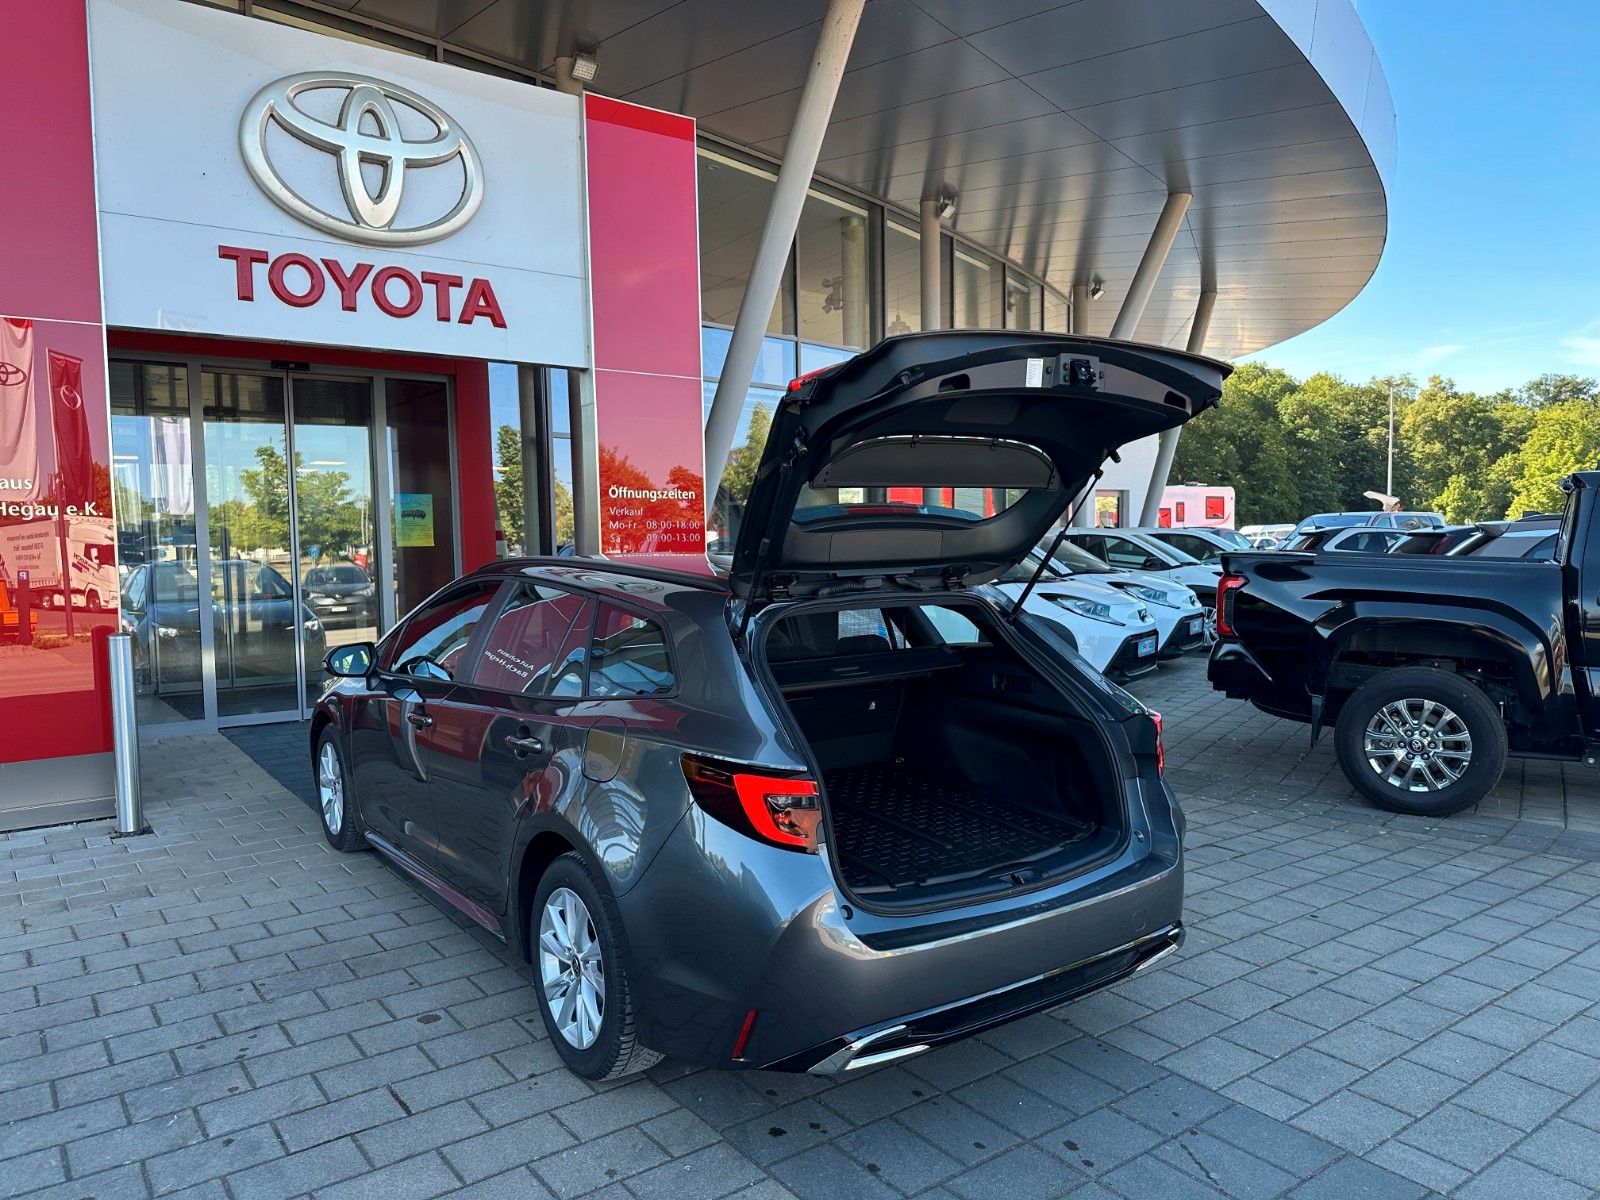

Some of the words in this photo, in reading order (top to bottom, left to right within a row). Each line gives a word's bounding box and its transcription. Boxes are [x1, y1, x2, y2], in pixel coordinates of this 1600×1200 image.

[218, 244, 507, 329] TOYOTA
[608, 485, 696, 502] Öffnungszeiten
[66, 501, 104, 516] e.K.
[609, 506, 644, 516] Verkauf
[609, 520, 638, 530] Mo-Fr
[646, 520, 700, 530] 08:00-18:00
[610, 533, 621, 543] Sa
